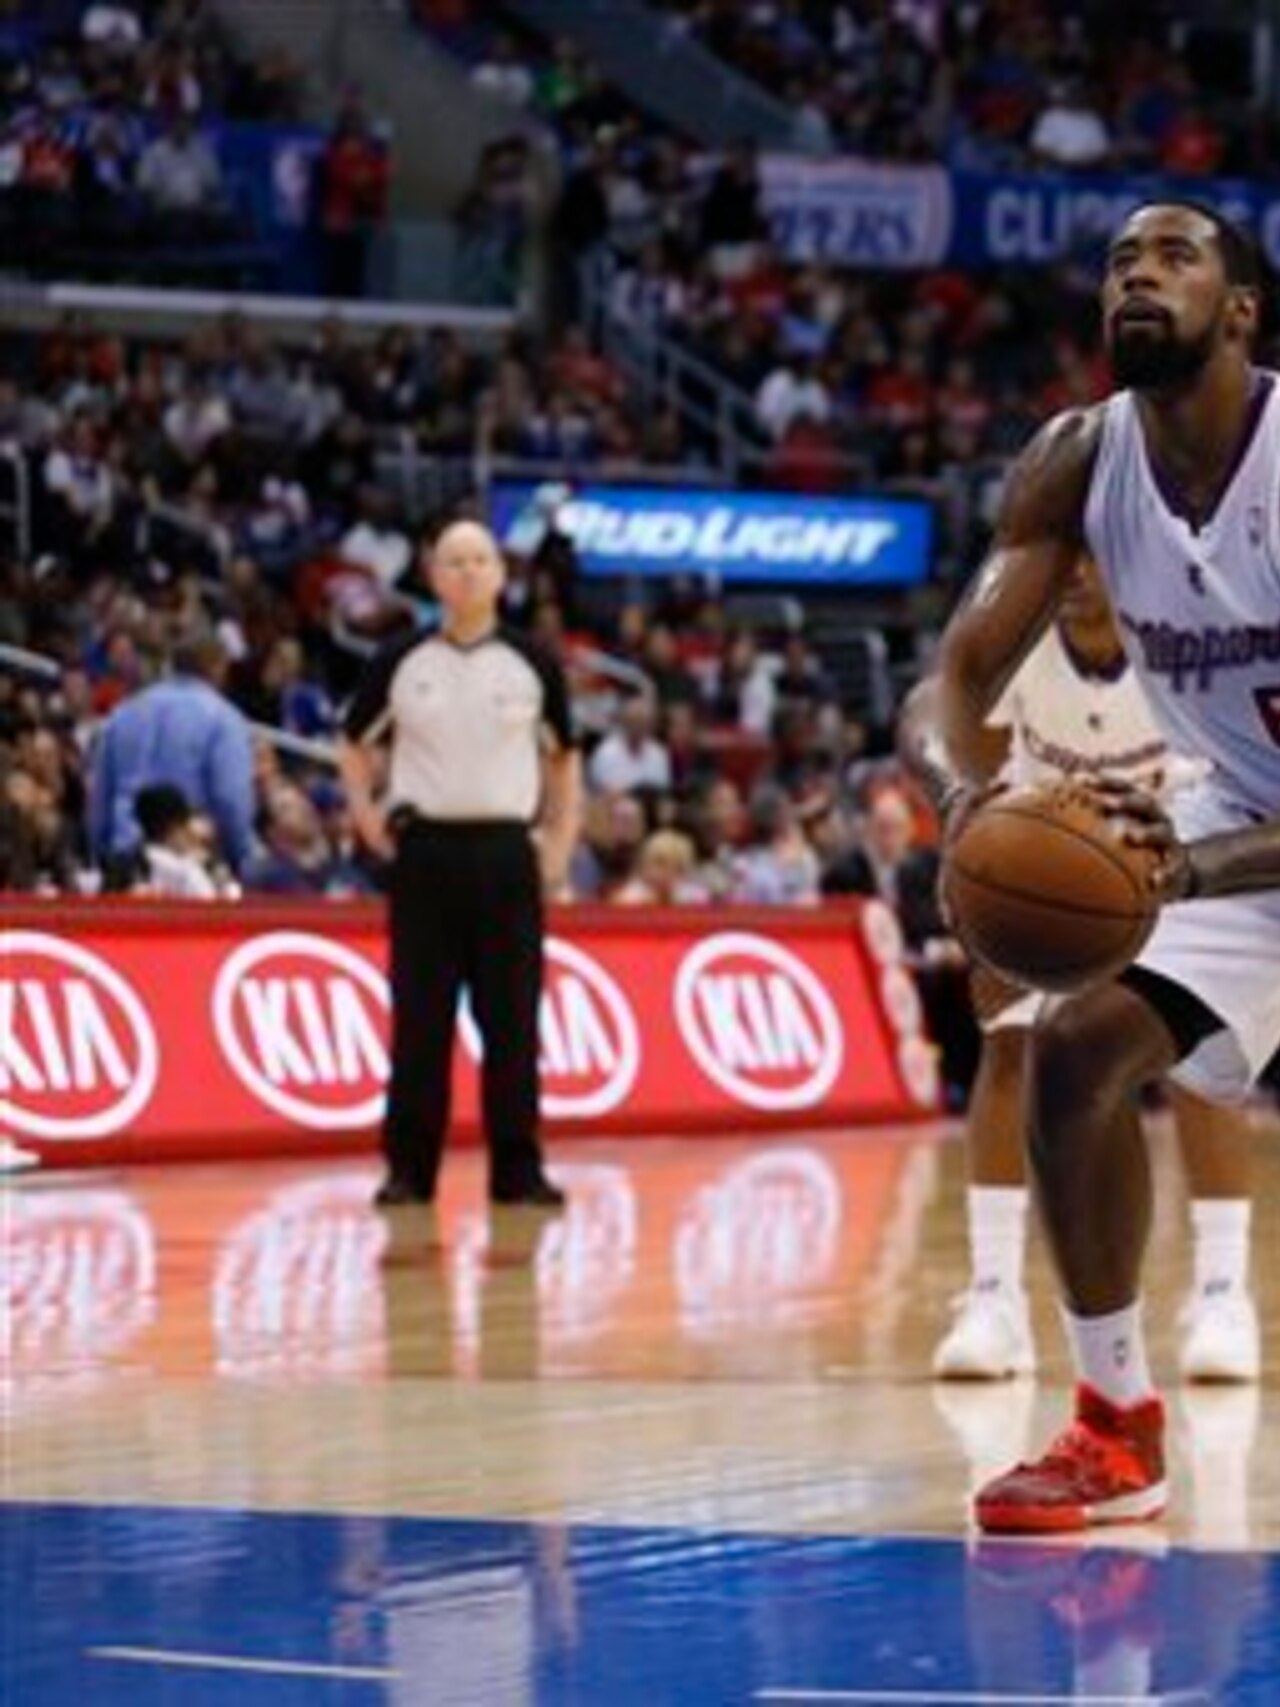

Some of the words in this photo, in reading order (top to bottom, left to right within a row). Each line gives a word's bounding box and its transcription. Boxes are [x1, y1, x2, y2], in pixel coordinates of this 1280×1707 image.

[695, 506, 896, 565] LIGHT
[238, 977, 391, 1085] KIA
[537, 974, 618, 1075] IA
[700, 973, 823, 1069] KIA
